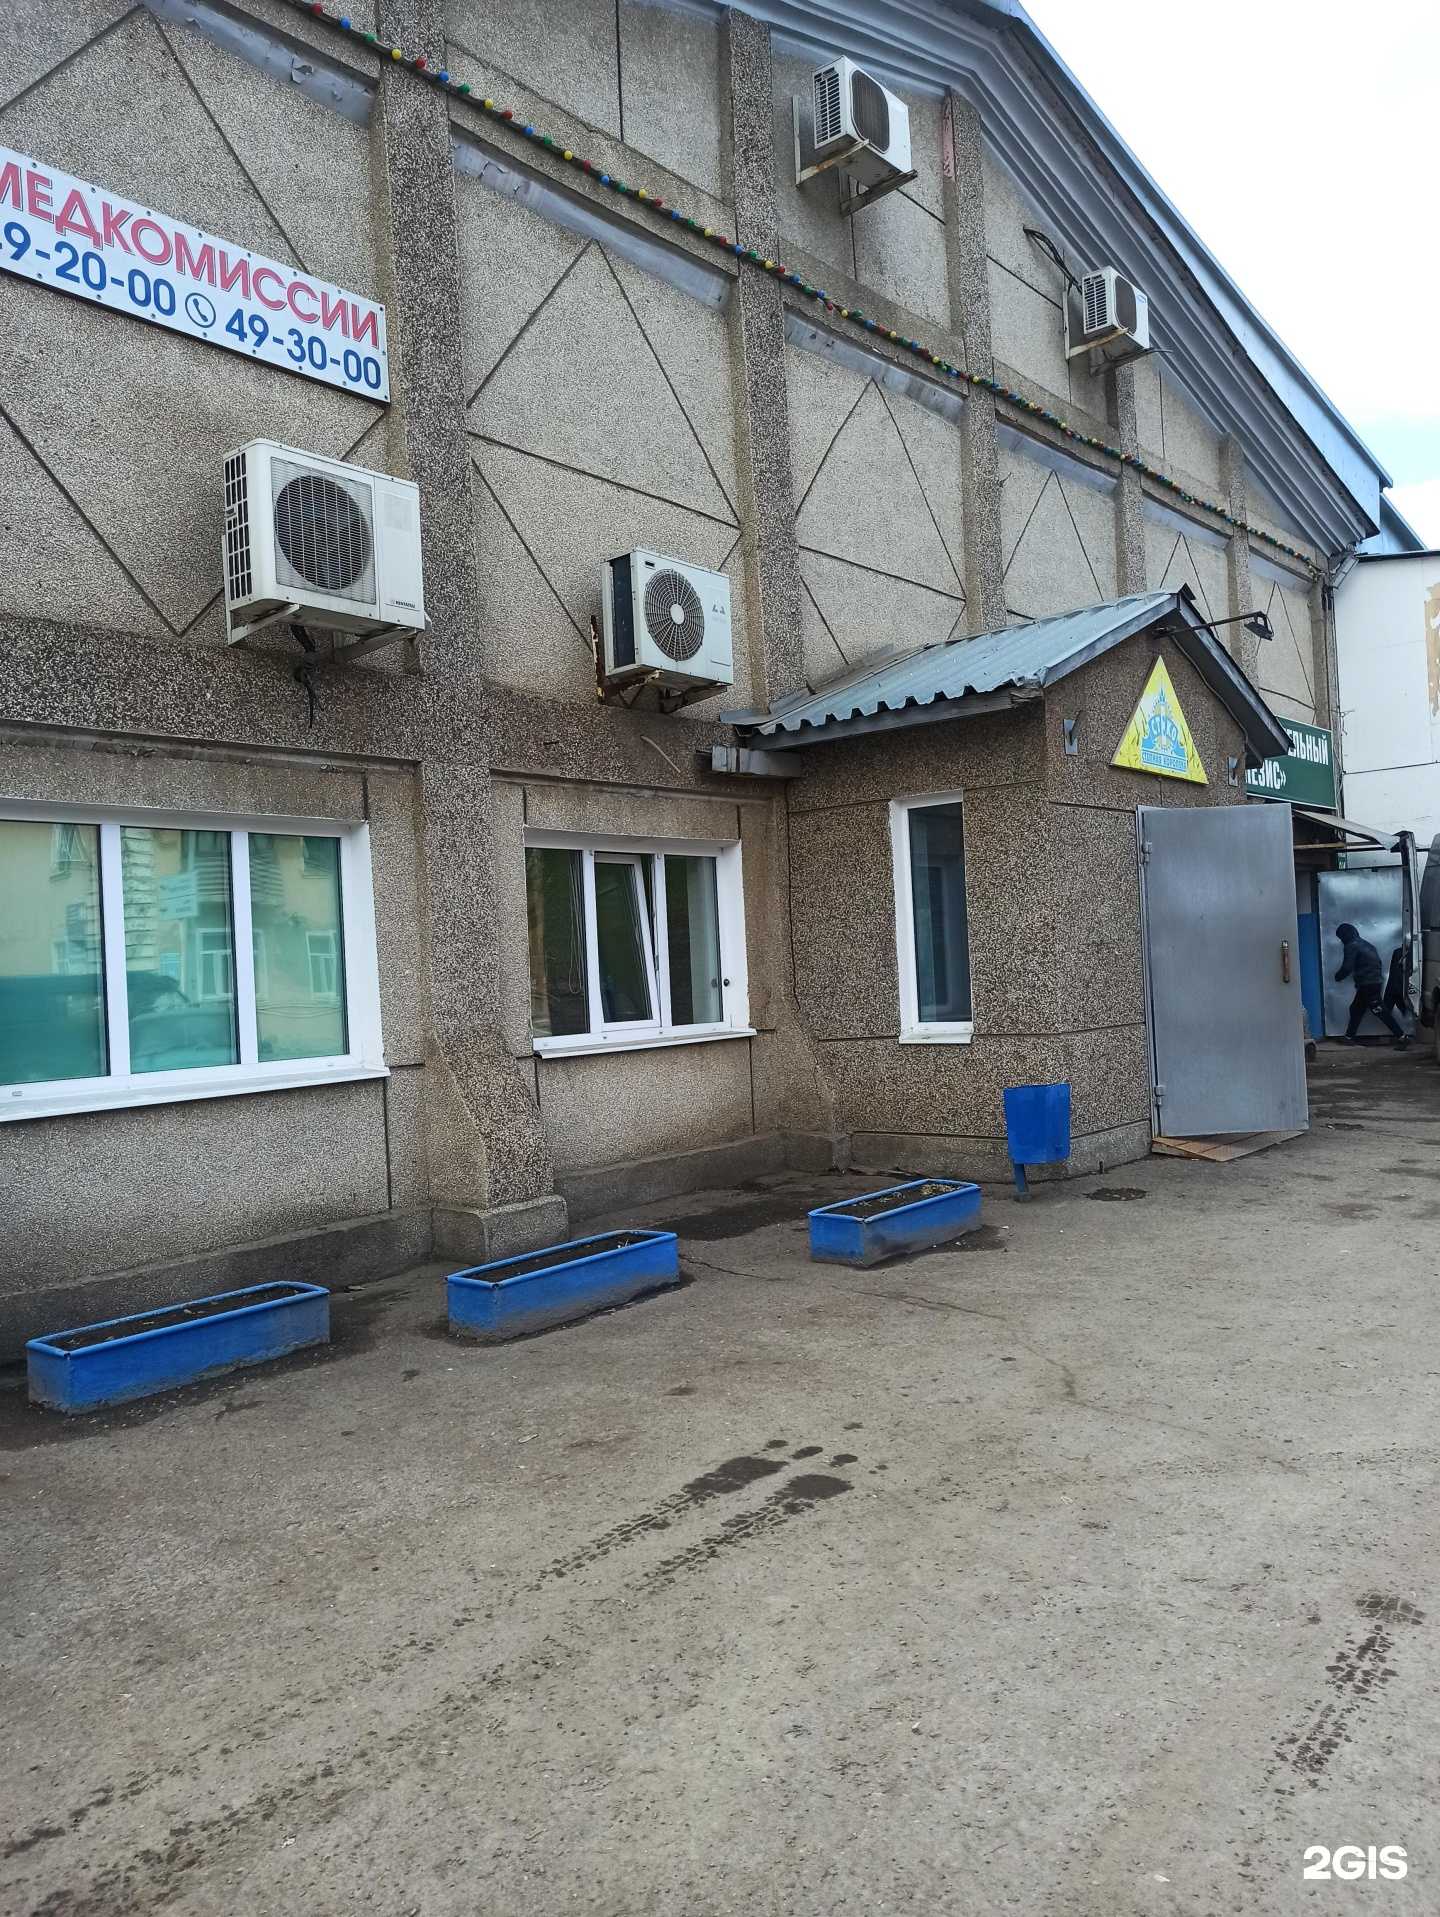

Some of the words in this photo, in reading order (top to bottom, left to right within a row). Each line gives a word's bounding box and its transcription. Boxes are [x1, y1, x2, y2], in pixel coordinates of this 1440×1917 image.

[0, 161, 380, 349] МЕДКОМИССИИ
[0, 221, 177, 317] 9-20-00
[225, 308, 381, 389] 49-30-00
